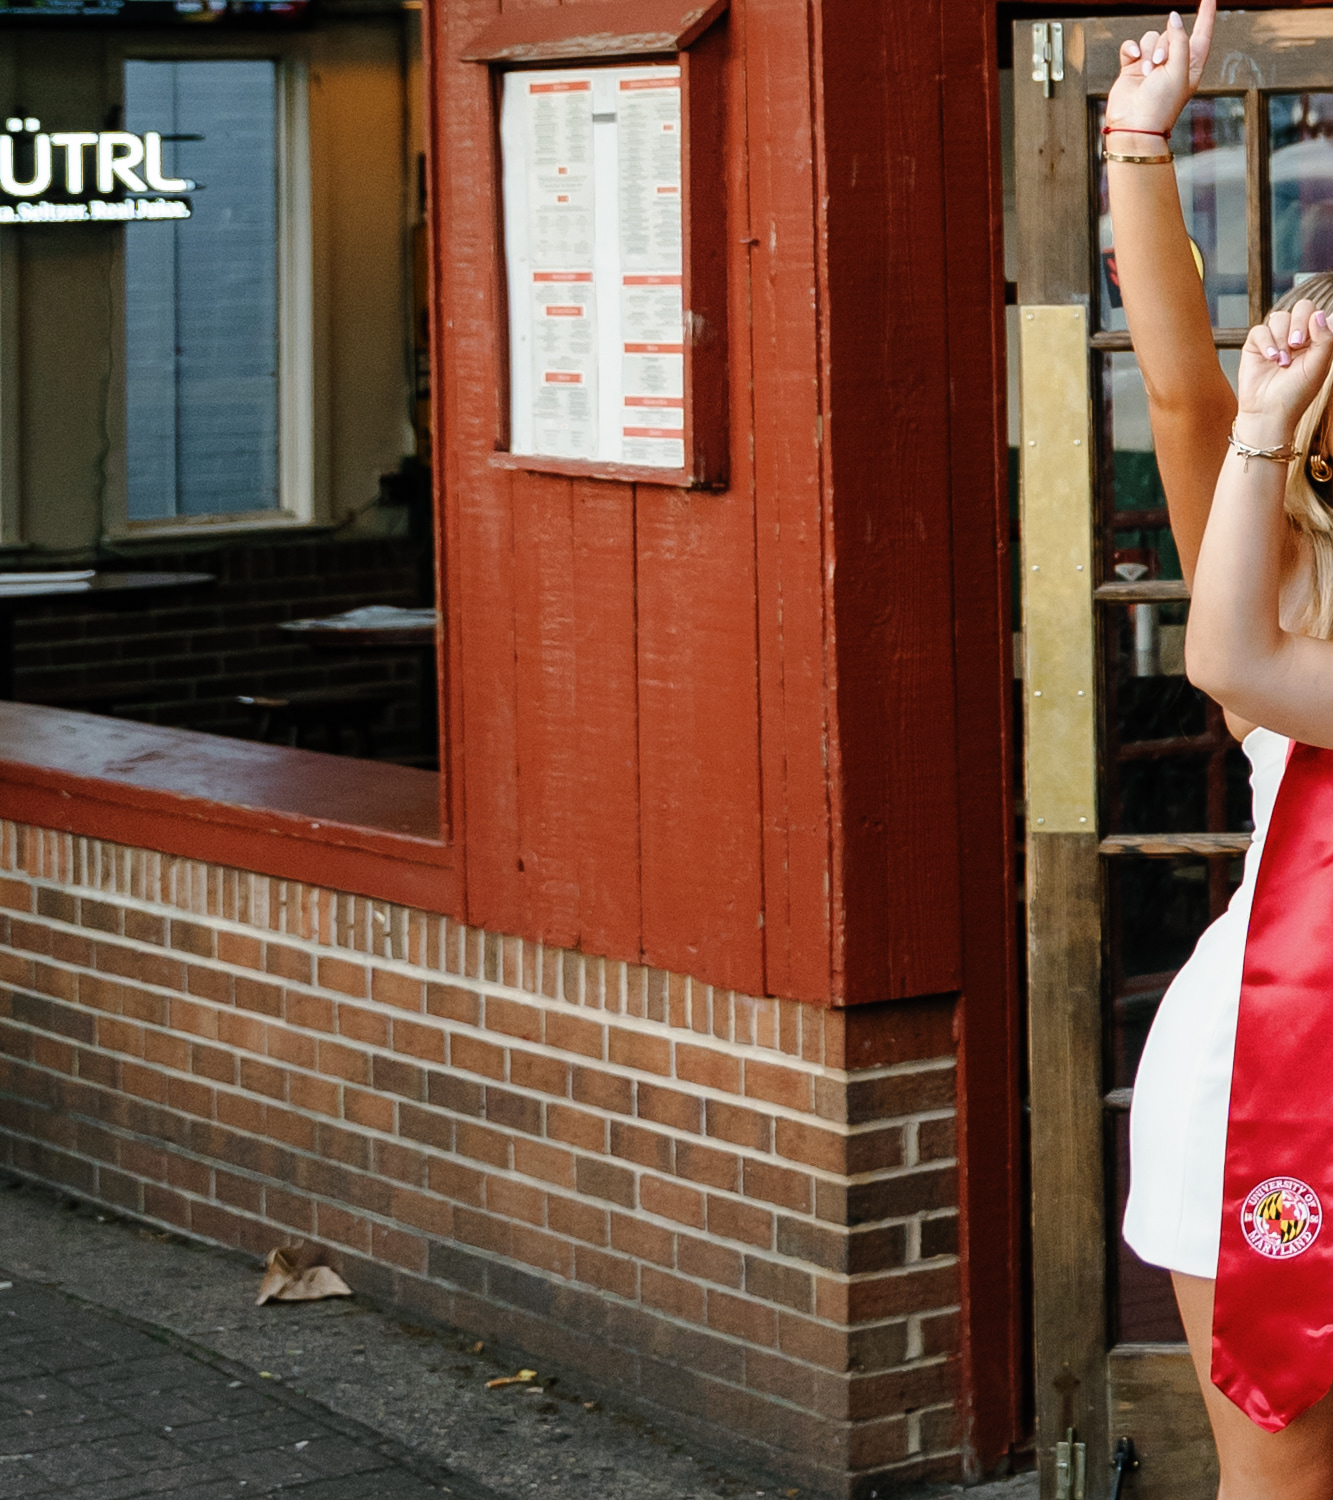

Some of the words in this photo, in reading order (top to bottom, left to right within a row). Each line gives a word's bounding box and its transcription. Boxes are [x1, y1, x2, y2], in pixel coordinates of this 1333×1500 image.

[1249, 1180, 1305, 1205] UNIVERSITY
[1305, 1193, 1316, 1207] OF
[1247, 1230, 1313, 1256] MARYLAND
